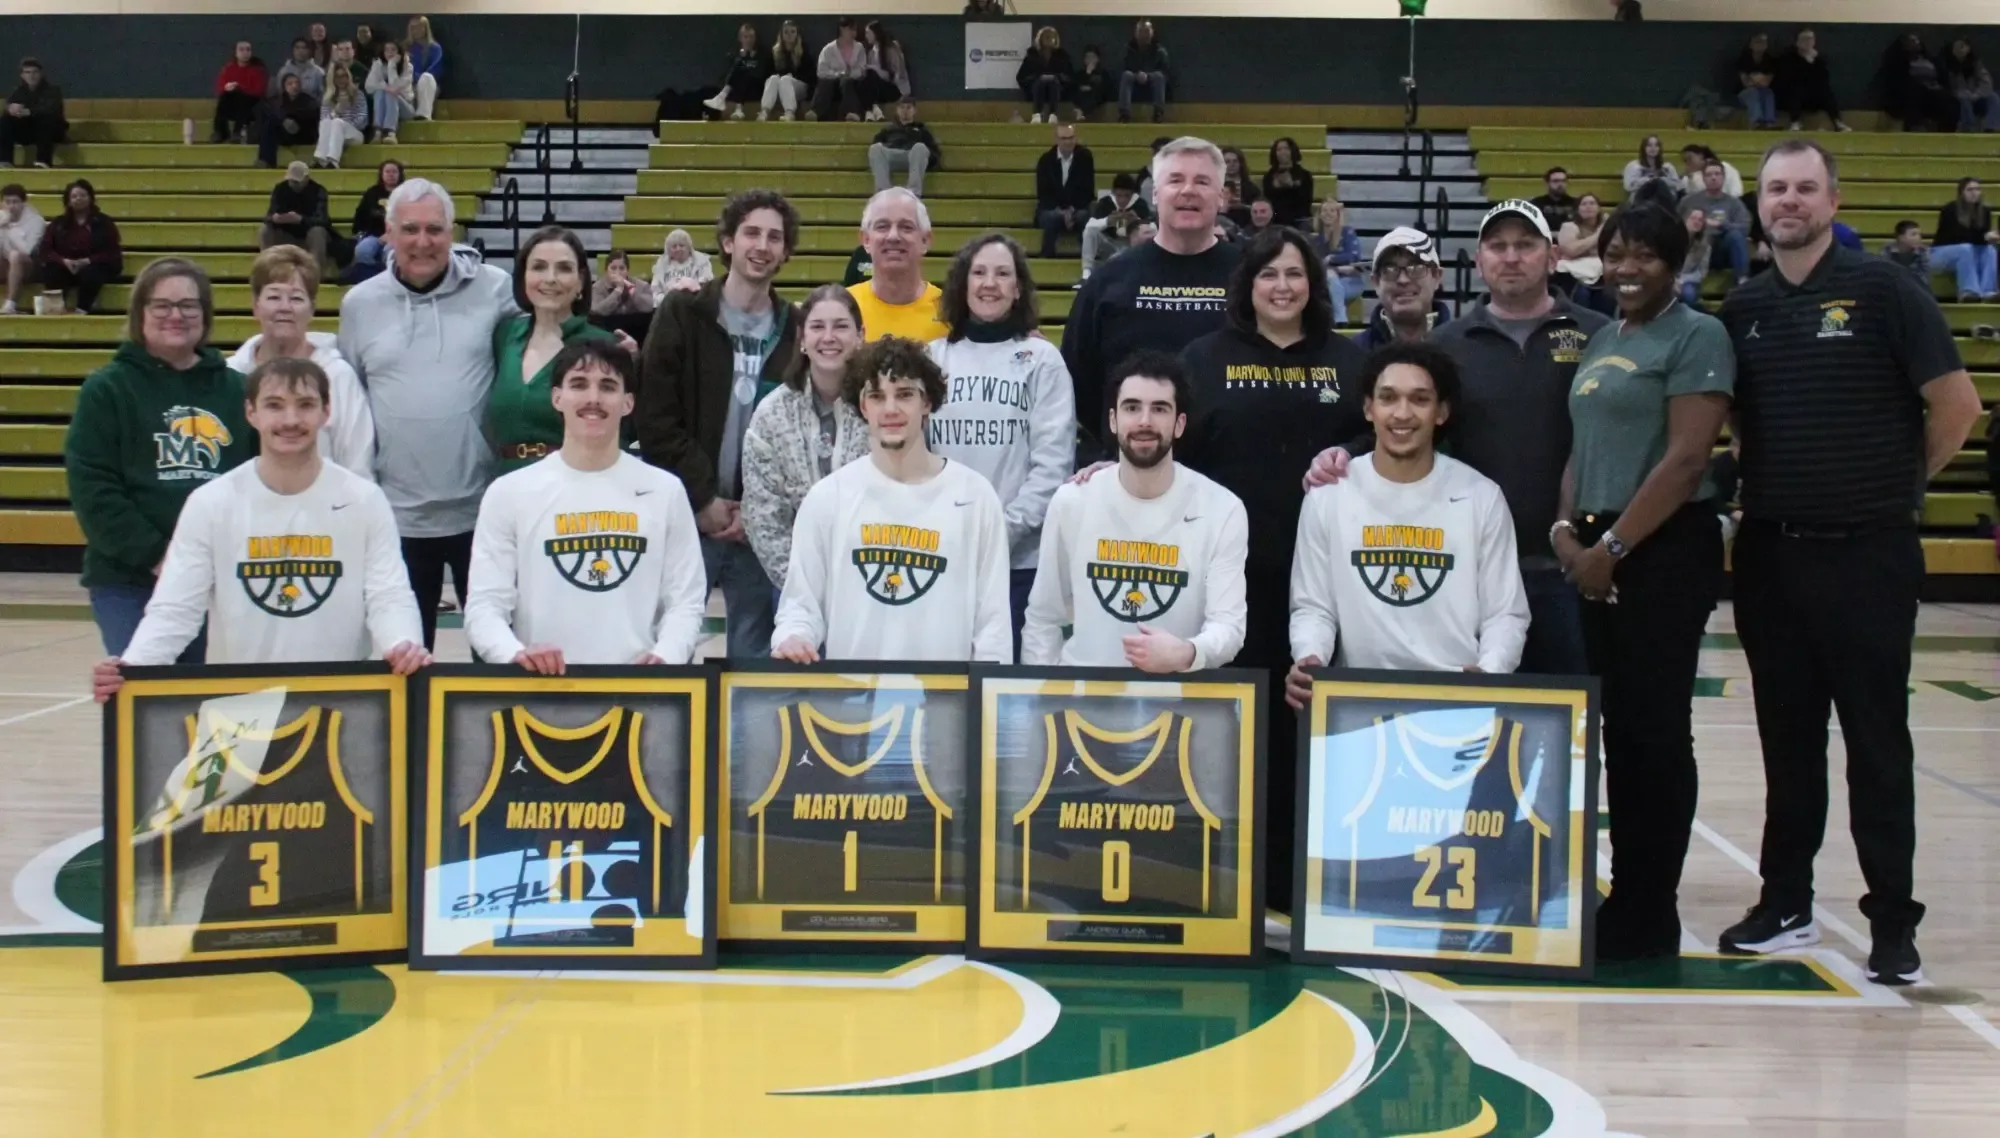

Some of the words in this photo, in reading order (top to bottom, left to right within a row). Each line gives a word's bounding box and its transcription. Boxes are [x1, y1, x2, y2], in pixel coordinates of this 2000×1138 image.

[1140, 286, 1226, 297] MARYWOOD
[1136, 301, 1228, 312] BASKETBAL
[1282, 366, 1338, 382] UNIVRSITY
[950, 375, 1029, 412] RYWOOD
[931, 418, 1031, 446] NIVERSITY
[153, 432, 204, 469] M
[157, 469, 222, 480] MARYWOO
[555, 511, 638, 535] MARYWOOD
[248, 535, 332, 559] MARYWOOD
[861, 524, 940, 552] MARYWOOD
[1363, 525, 1444, 550] MARYWOOD
[1097, 539, 1179, 567] MARYWOOD
[203, 801, 326, 834] MARYWOOD
[506, 801, 625, 830] MARYWOOD
[793, 793, 908, 821] MARYWOOD
[1059, 802, 1175, 832] MARYWOOD
[1387, 806, 1505, 838] MARYWOOD
[249, 842, 280, 907] 3
[548, 840, 584, 904] 11
[843, 830, 858, 892] 1
[1102, 840, 1131, 902] 0
[1412, 844, 1476, 910] 23
